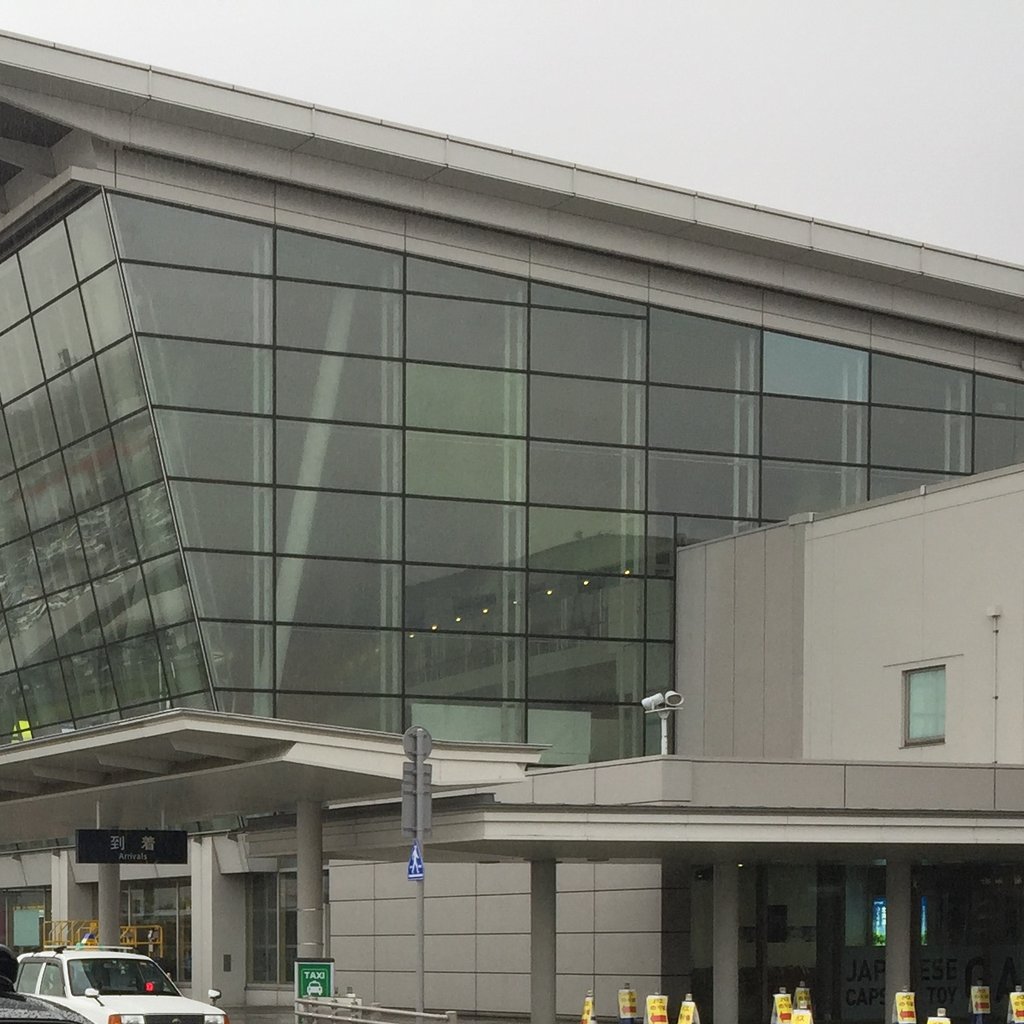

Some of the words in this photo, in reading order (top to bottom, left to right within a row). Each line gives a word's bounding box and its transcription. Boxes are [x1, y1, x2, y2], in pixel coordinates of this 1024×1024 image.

[110, 835, 156, 851] 到着
[119, 852, 148, 860] Arrivals
[304, 971, 326, 980] TAXI
[846, 958, 958, 982] JAPESE
[926, 986, 958, 1005] TOY
